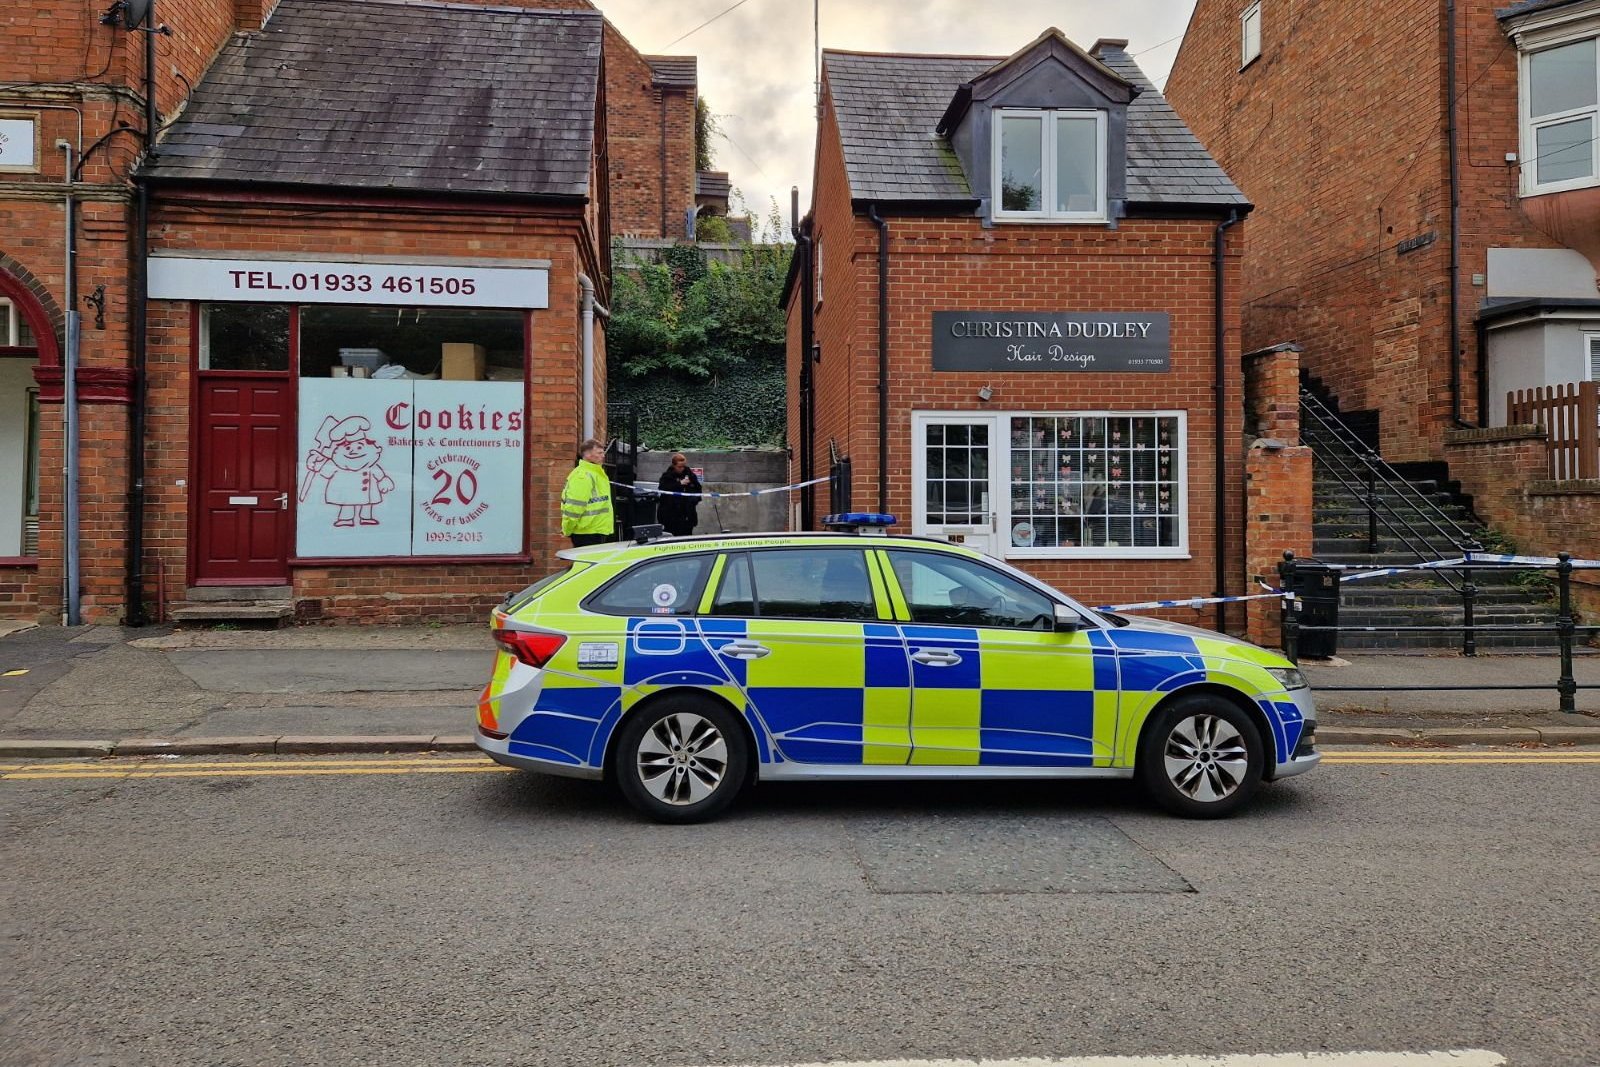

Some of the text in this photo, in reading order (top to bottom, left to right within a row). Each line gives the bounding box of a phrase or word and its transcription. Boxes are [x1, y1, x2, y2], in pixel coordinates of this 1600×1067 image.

[229, 270, 475, 295] TEL.01933 461505
[951, 321, 1152, 338] CHRISTINA DUDLEY
[1006, 344, 1096, 368] Hair Design
[385, 401, 523, 431] Cookies
[388, 436, 521, 448] Bakers & Confectioners Ltd
[427, 453, 481, 471] Celebrating
[431, 468, 478, 506] 20
[445, 516, 456, 526] of
[459, 502, 489, 525] baking
[425, 531, 483, 542] 1995-2015
